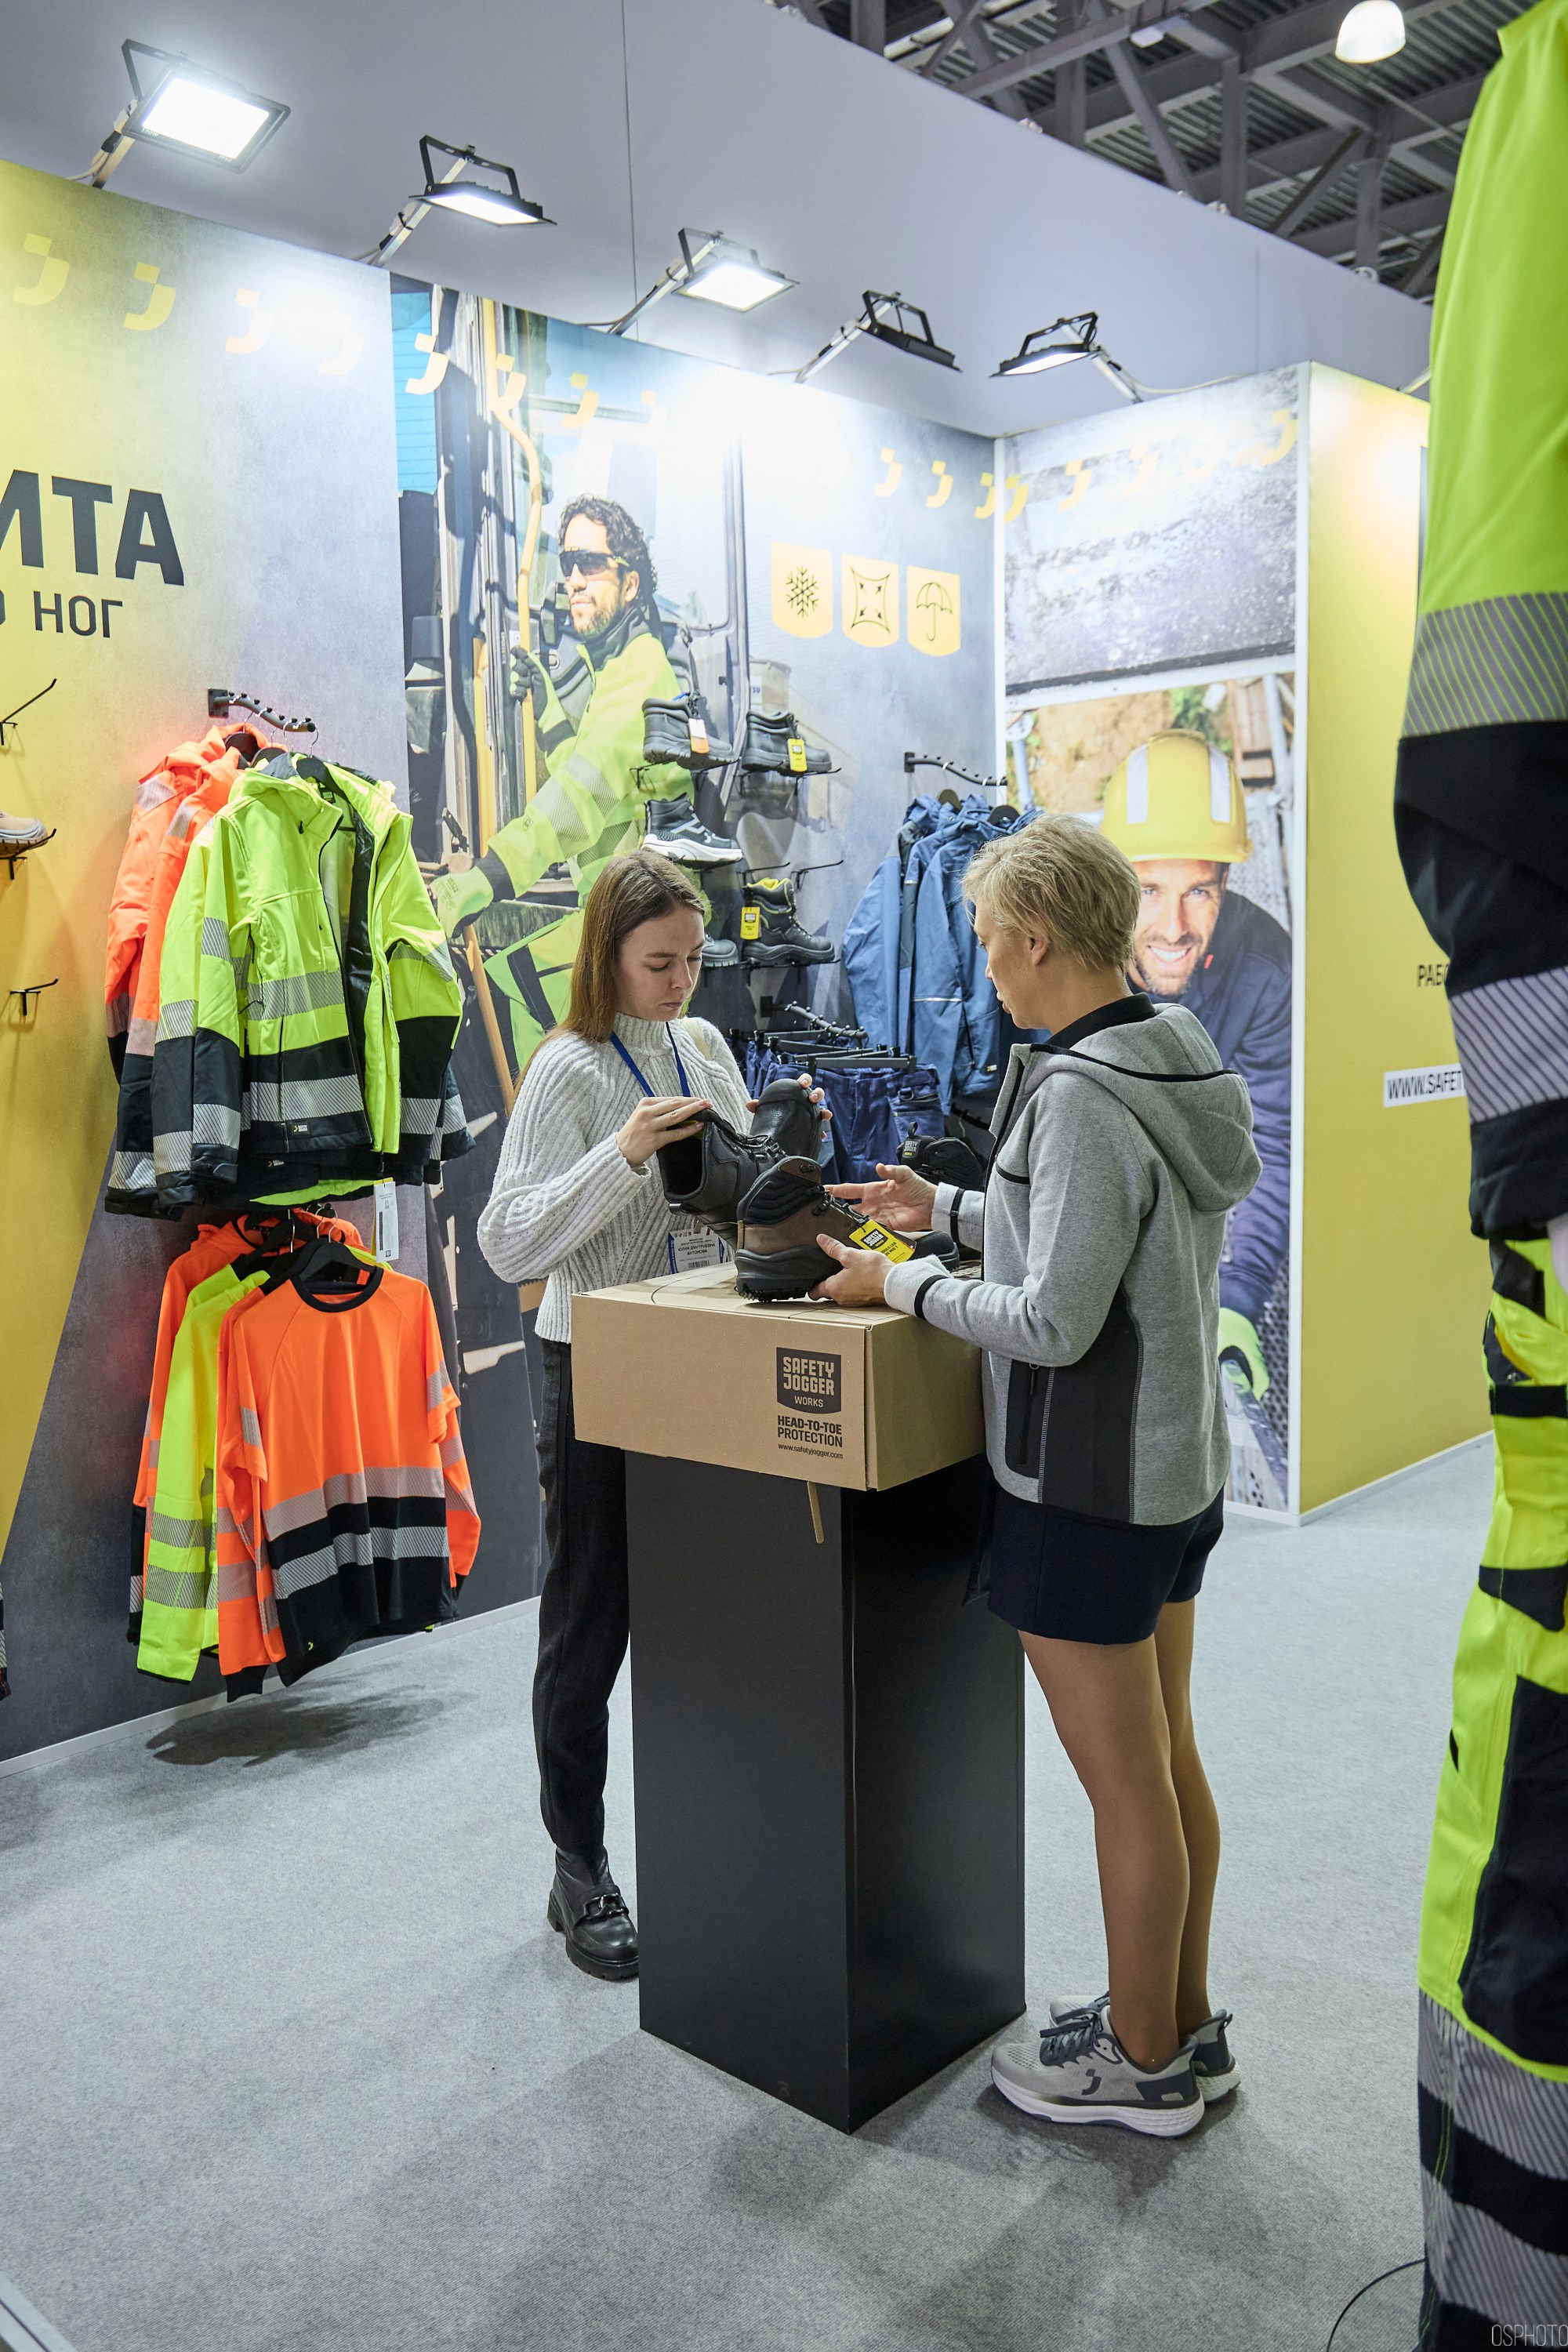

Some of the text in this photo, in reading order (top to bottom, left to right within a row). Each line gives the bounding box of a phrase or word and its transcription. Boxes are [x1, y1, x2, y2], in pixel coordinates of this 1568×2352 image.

[33, 590, 123, 638] НОГ
[782, 1356, 834, 1378] SAFETY
[782, 1374, 835, 1396] JOGGER
[794, 1396, 824, 1408] WORKS
[777, 1415, 843, 1436] HEAD-TO-TOE
[777, 1427, 844, 1448] PROTECTION
[778, 1443, 844, 1460] www.safetyjogger.com
